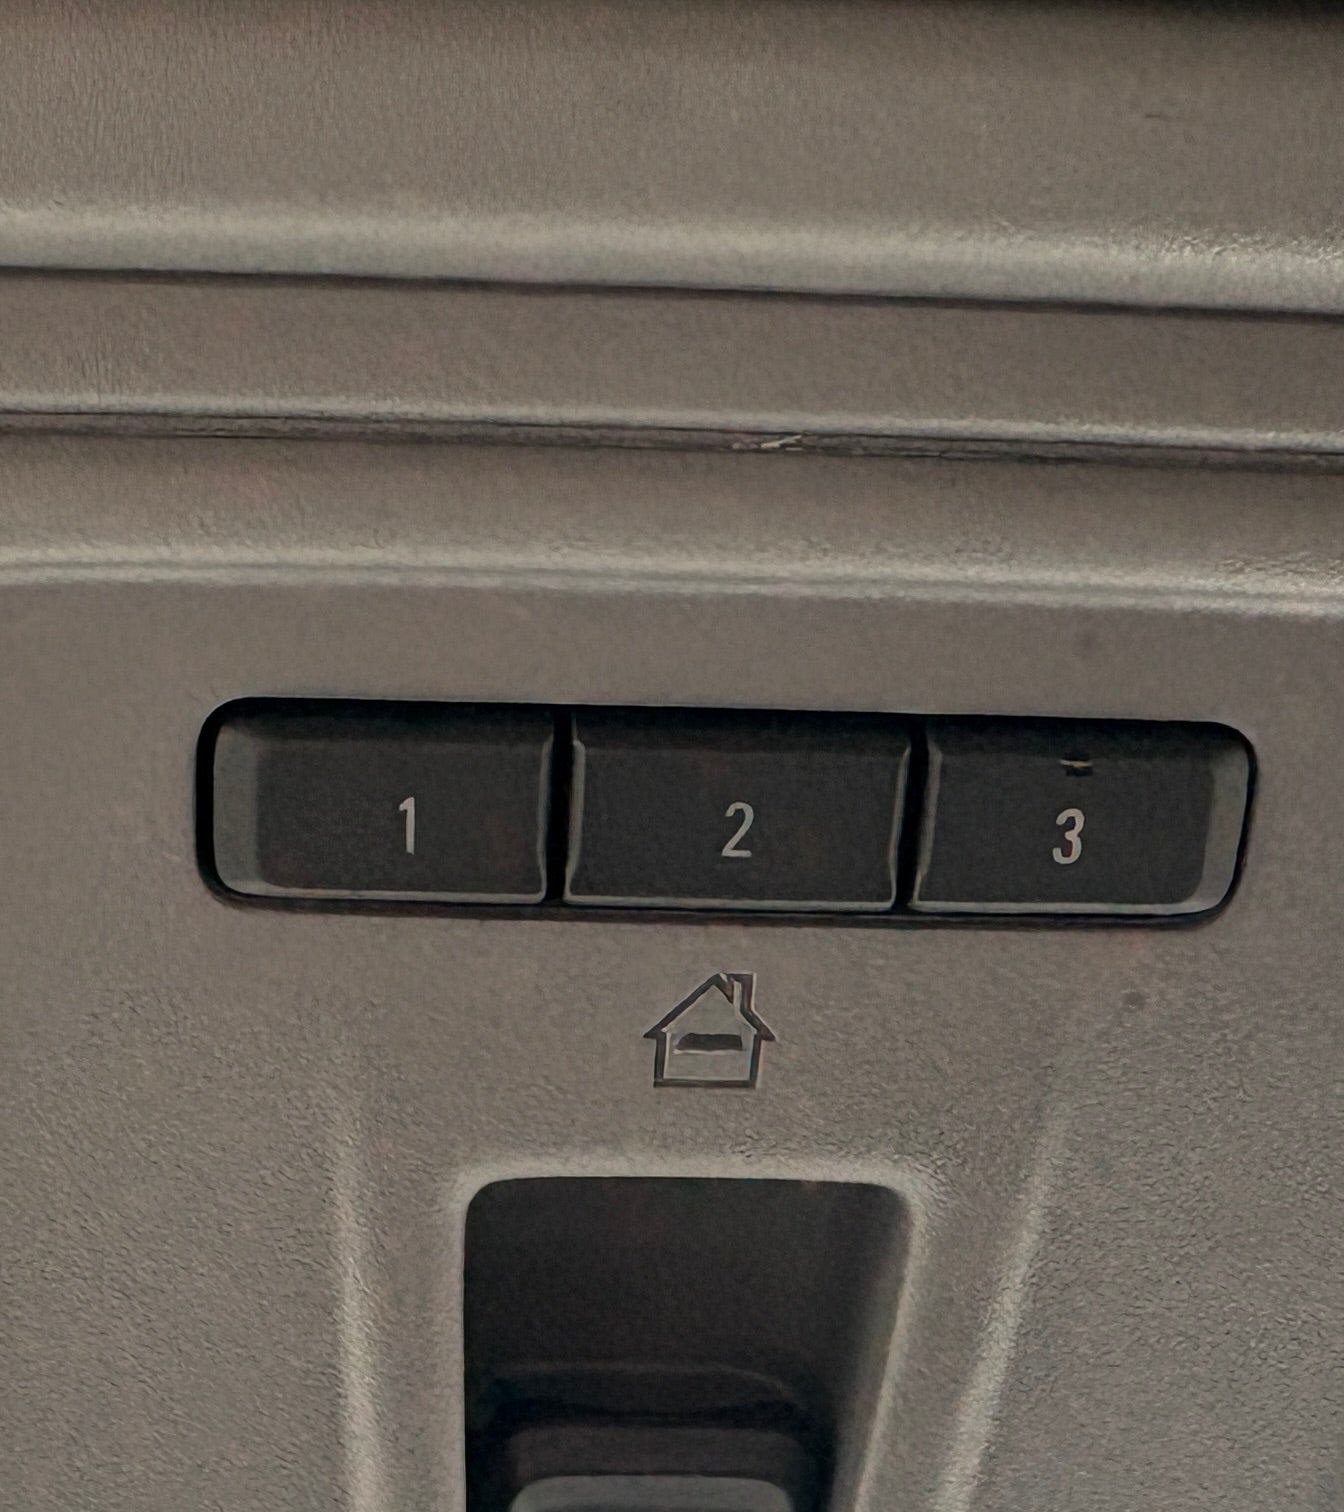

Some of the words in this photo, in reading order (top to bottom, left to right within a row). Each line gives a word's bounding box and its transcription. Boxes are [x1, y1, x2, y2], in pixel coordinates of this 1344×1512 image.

[399, 797, 417, 855] 1
[722, 803, 755, 858] 2
[1052, 808, 1087, 865] 3
